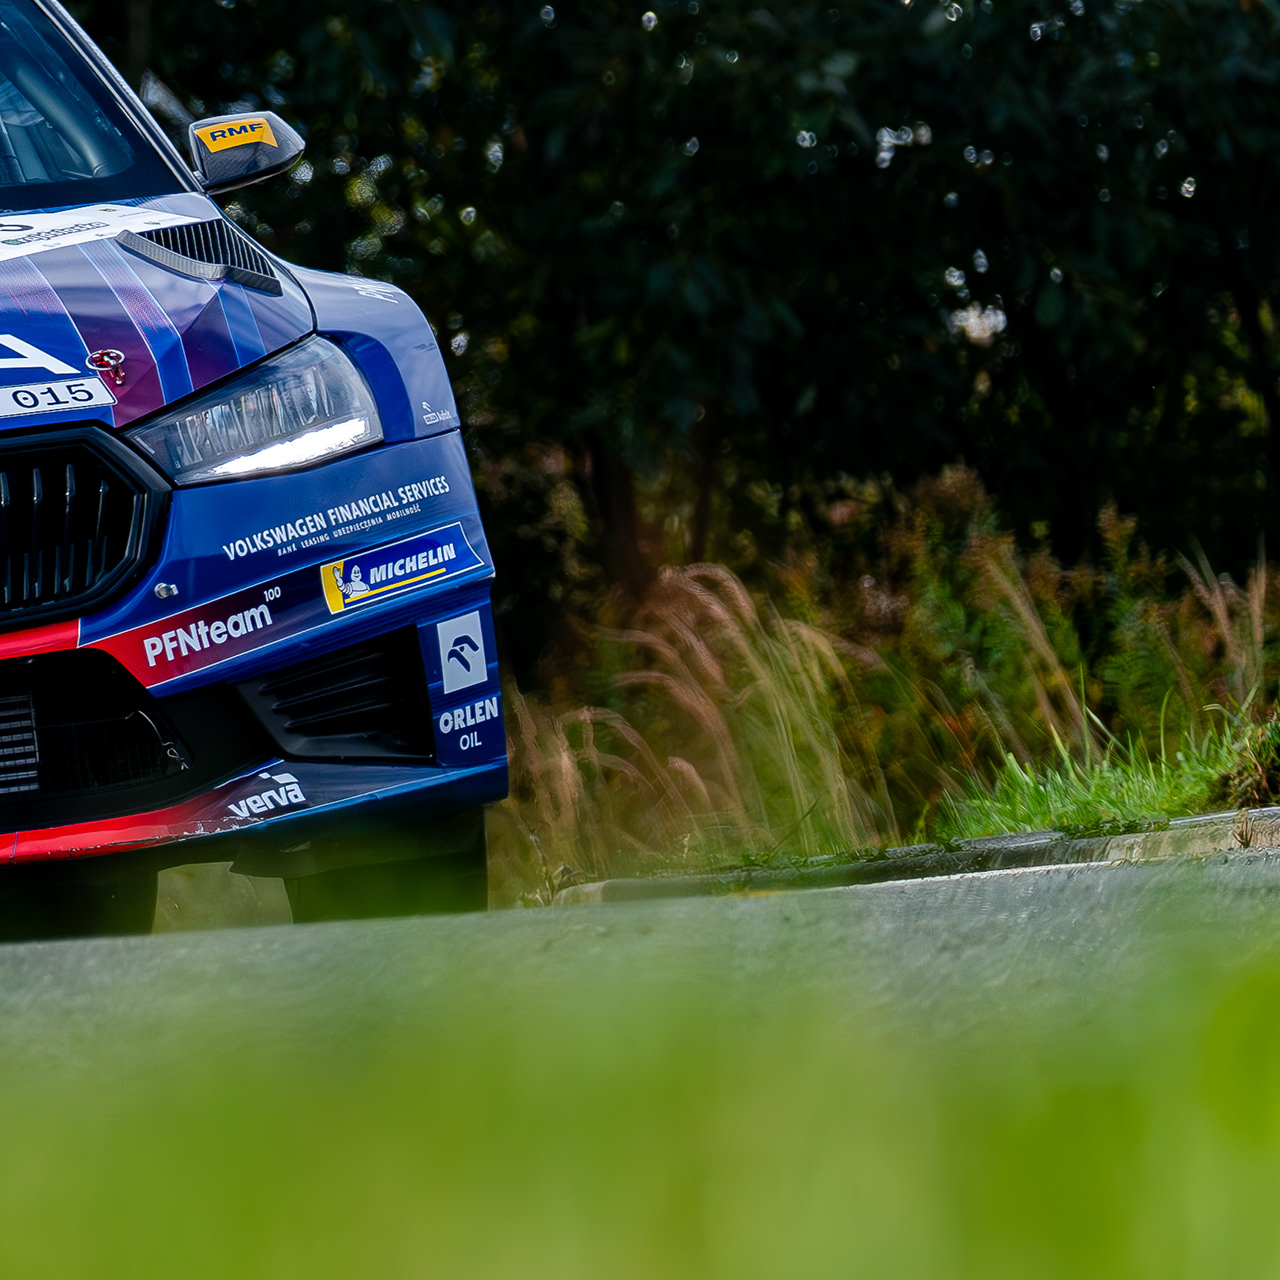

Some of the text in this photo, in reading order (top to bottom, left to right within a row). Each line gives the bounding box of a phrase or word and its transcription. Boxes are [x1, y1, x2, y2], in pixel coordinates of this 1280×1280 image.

[209, 122, 264, 142] RMF
[12, 383, 95, 409] 015
[222, 475, 451, 561] VOLKSWAGEN FINANCIAL SERVICES
[277, 544, 298, 557] BANK
[300, 534, 330, 549] LEASING
[332, 517, 383, 538] UBEZPIECZENIA
[369, 543, 457, 585] MICHELIN
[440, 697, 499, 733] ORLEN
[459, 731, 482, 751] OIL
[228, 782, 306, 818] verva
